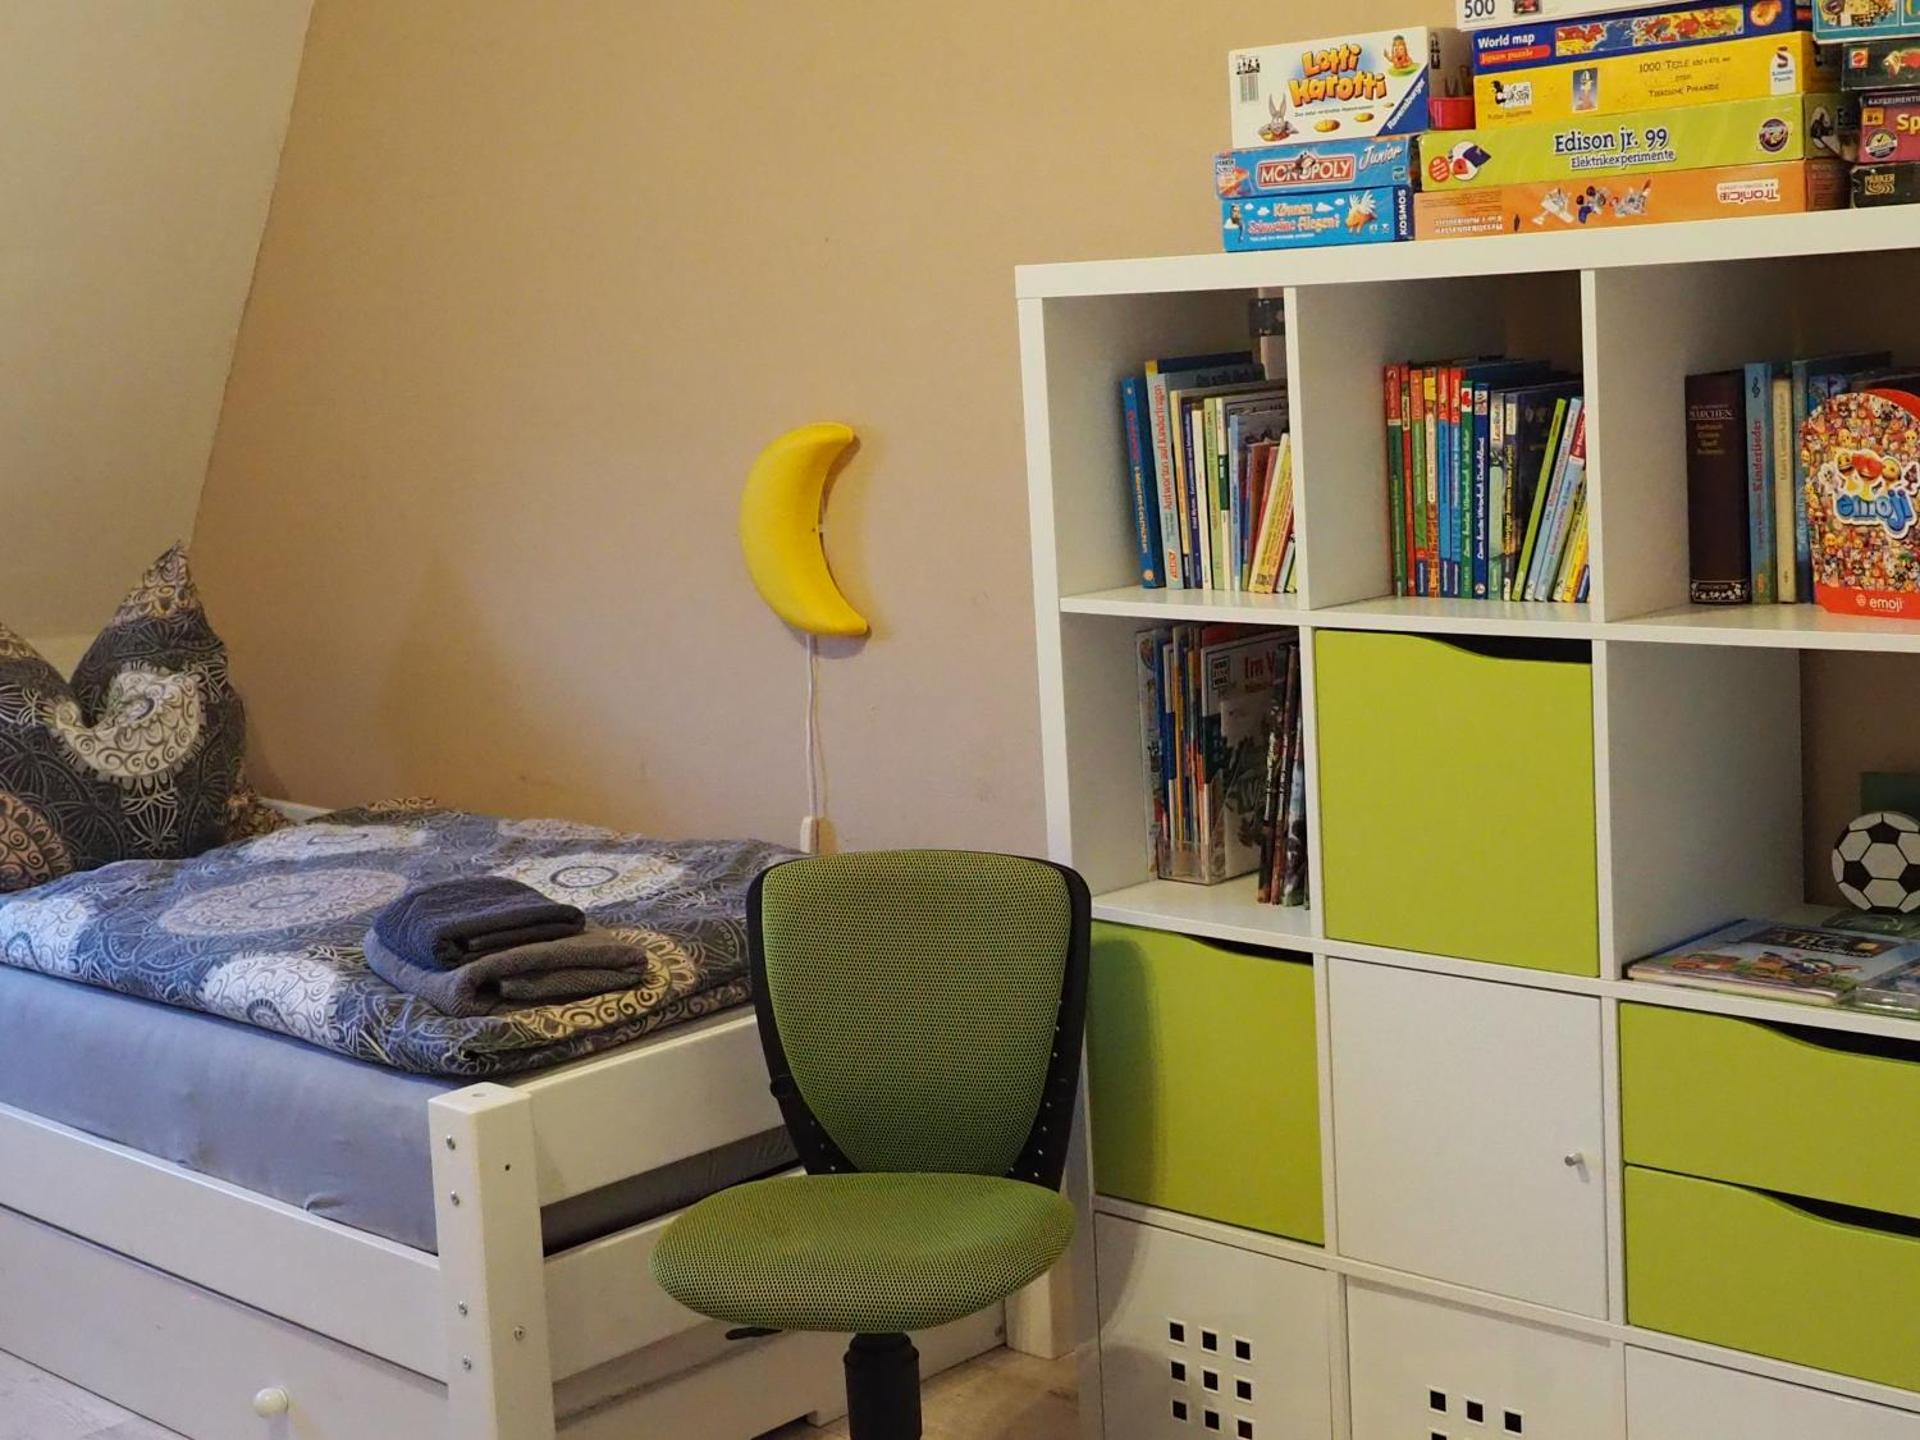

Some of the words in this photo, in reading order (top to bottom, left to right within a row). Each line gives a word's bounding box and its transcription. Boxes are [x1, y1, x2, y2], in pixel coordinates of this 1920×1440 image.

[1464, 0, 1495, 18] 500
[1478, 36, 1509, 49] World
[1512, 33, 1535, 45] map
[1302, 43, 1362, 77] Lotti
[1639, 62, 1661, 73] 1000
[1288, 71, 1388, 107] Karotti
[1555, 131, 1615, 153] Edison
[1620, 127, 1638, 153] jr.
[1645, 128, 1668, 148] 99
[1358, 143, 1403, 170] Junior
[1571, 150, 1675, 169] Elektrikexperimente
[1398, 189, 1407, 236] KOSMOS
[1751, 420, 1763, 492] Kinderlieder
[1159, 461, 1173, 511] Antworten
[1836, 489, 1913, 532] emoji
[1869, 597, 1904, 612] emoji
